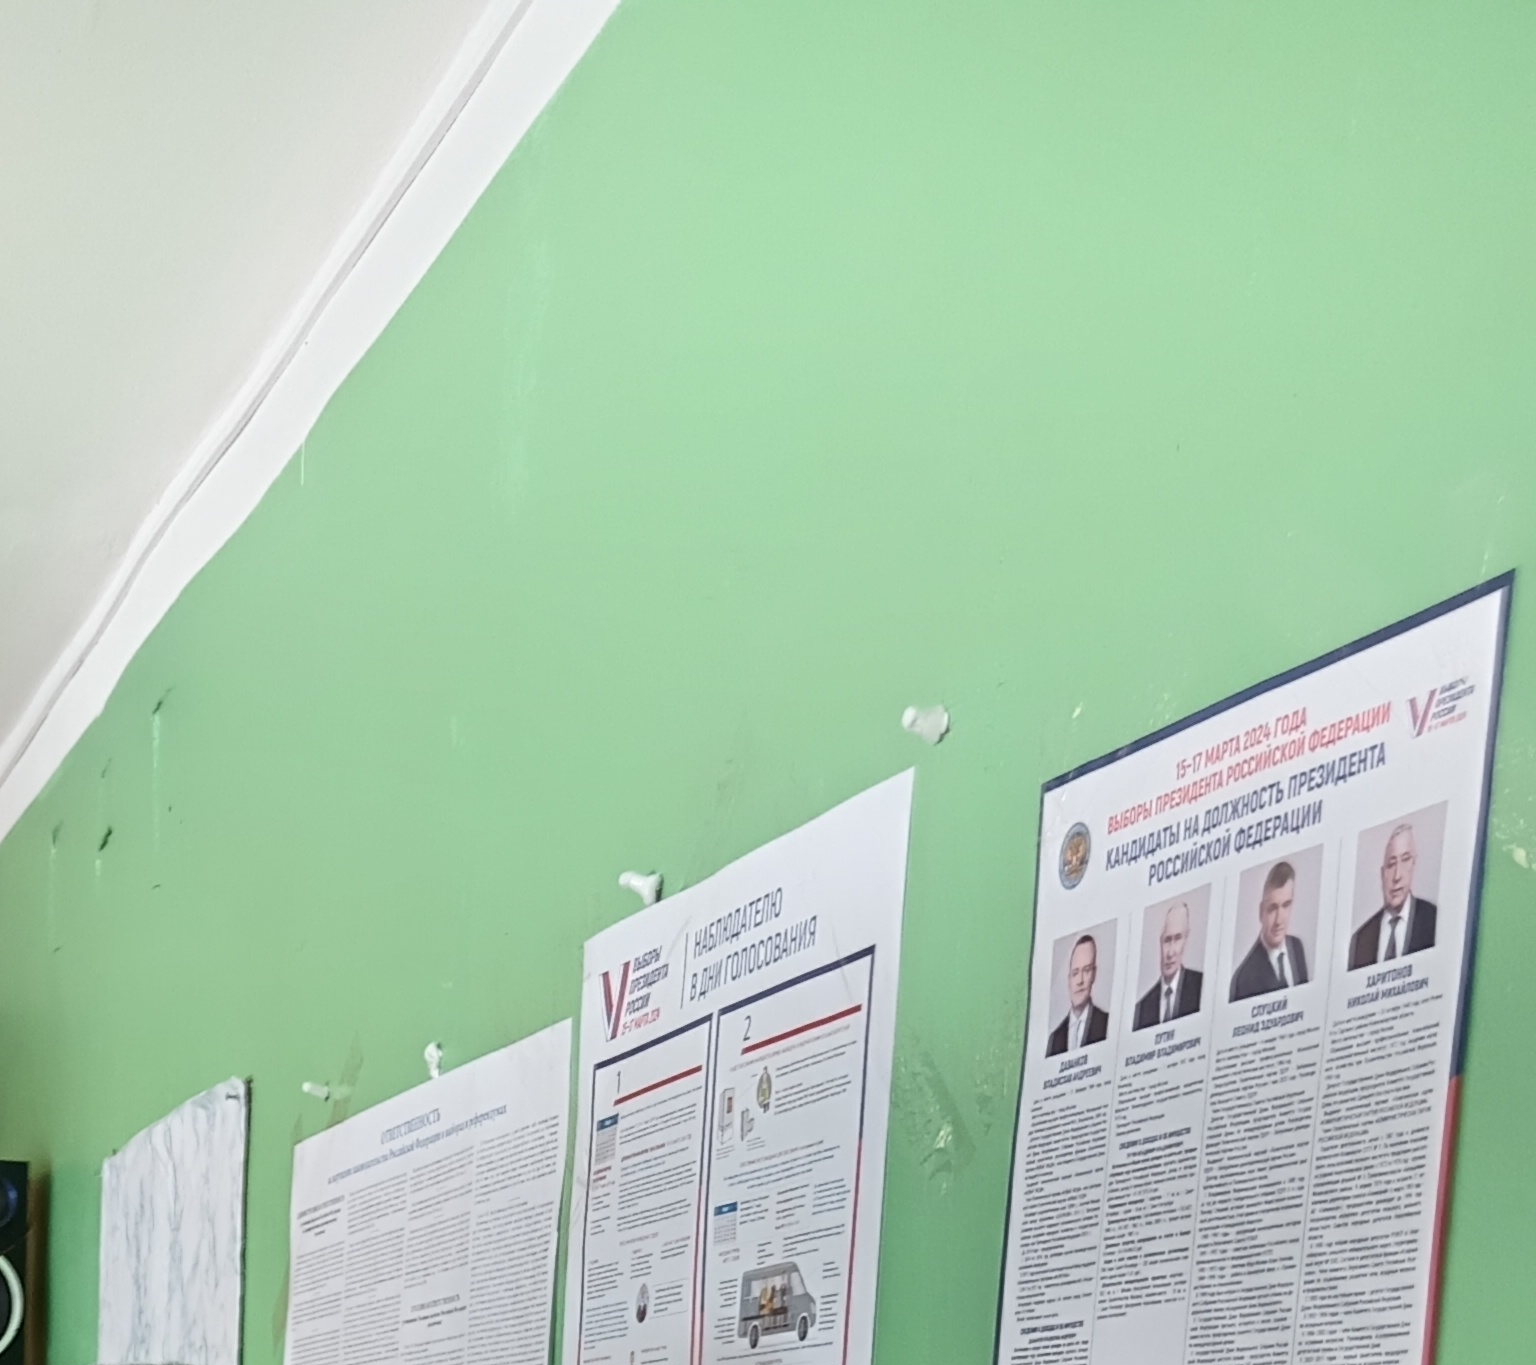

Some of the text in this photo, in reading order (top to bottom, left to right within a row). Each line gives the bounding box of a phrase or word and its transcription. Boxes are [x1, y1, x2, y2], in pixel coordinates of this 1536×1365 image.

[1108, 799, 1153, 835] ВЫБОРЫ
[1154, 773, 1224, 816] ПРЕЗИДЕНТА
[1226, 731, 1306, 786] РОССИЙСКОЙ
[1308, 701, 1391, 752] ФЕДЕРАЦИИ
[1204, 736, 1241, 772] МАРТА
[1243, 722, 1272, 752] 2024
[1274, 707, 1307, 738] ГОДА
[1106, 742, 1386, 871] КАНДИДАТЫ НА ДОЛЖНОСТЬ ПРЕЗИДЕНТА
[1148, 799, 1323, 886] РОССИЙСКОЙ ФЕДЕРАЦИИ
[690, 915, 817, 1001] В ДНИ ГОЛОСОВАНИЯ
[694, 887, 783, 959] НАБЛЮДАТЕЛЮ
[743, 1015, 752, 1042] 2
